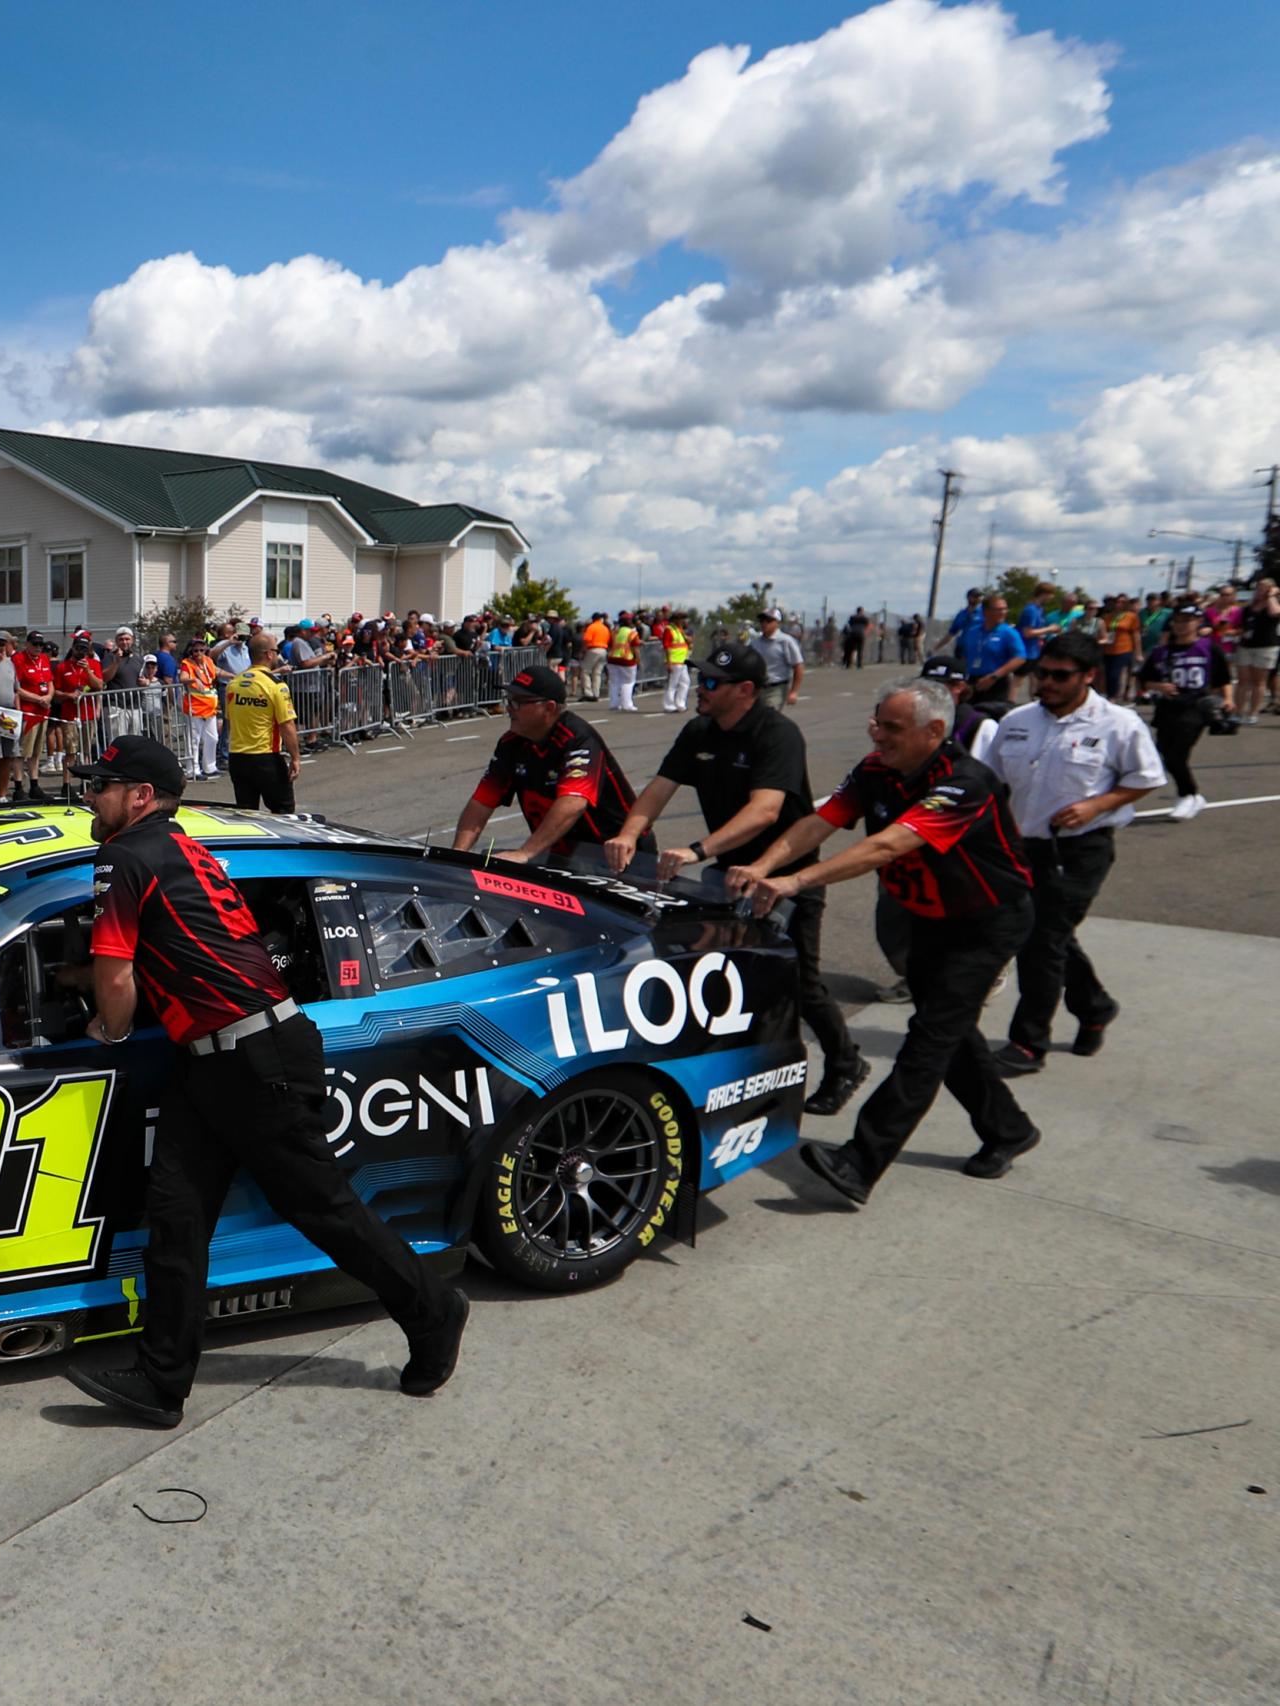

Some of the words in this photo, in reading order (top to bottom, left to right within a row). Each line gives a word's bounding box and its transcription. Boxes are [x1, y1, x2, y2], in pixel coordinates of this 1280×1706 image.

[482, 877, 548, 900] PROJECT
[553, 891, 575, 910] 91
[536, 951, 754, 1059] iLOQ
[704, 1079, 745, 1114] RACE
[742, 1060, 808, 1101] SERVICE
[497, 1152, 520, 1235] EAGLE
